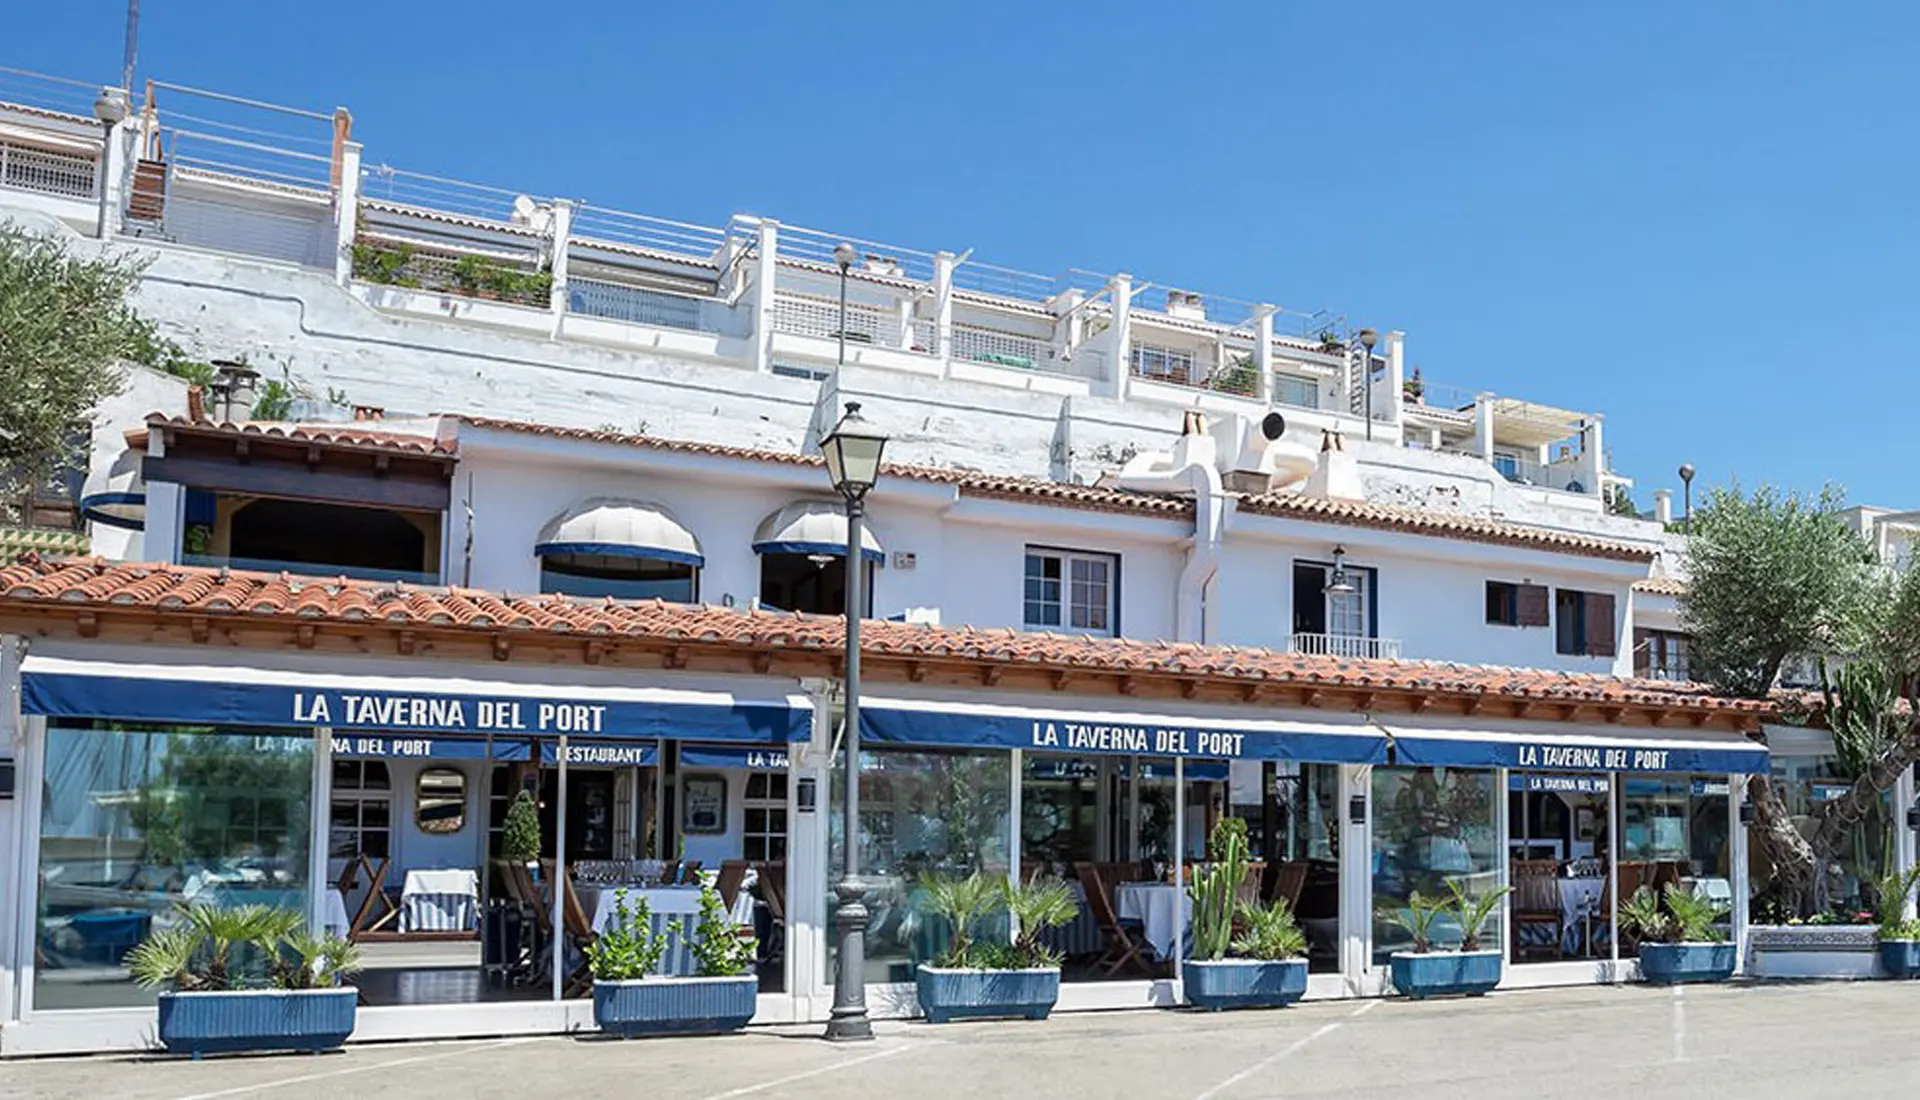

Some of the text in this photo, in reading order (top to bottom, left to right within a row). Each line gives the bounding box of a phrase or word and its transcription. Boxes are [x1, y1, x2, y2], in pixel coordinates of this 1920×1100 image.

[293, 693, 606, 732] LA TAVERNA DEL PORT
[357, 739, 386, 755] DEL
[393, 741, 432, 756] PORT
[1033, 722, 1245, 756] LA TAVERNA DEL PORT
[747, 752, 766, 768] LA
[1519, 746, 1669, 770] LA TAVERNA DEL PORT
[1531, 777, 1541, 790] LA
